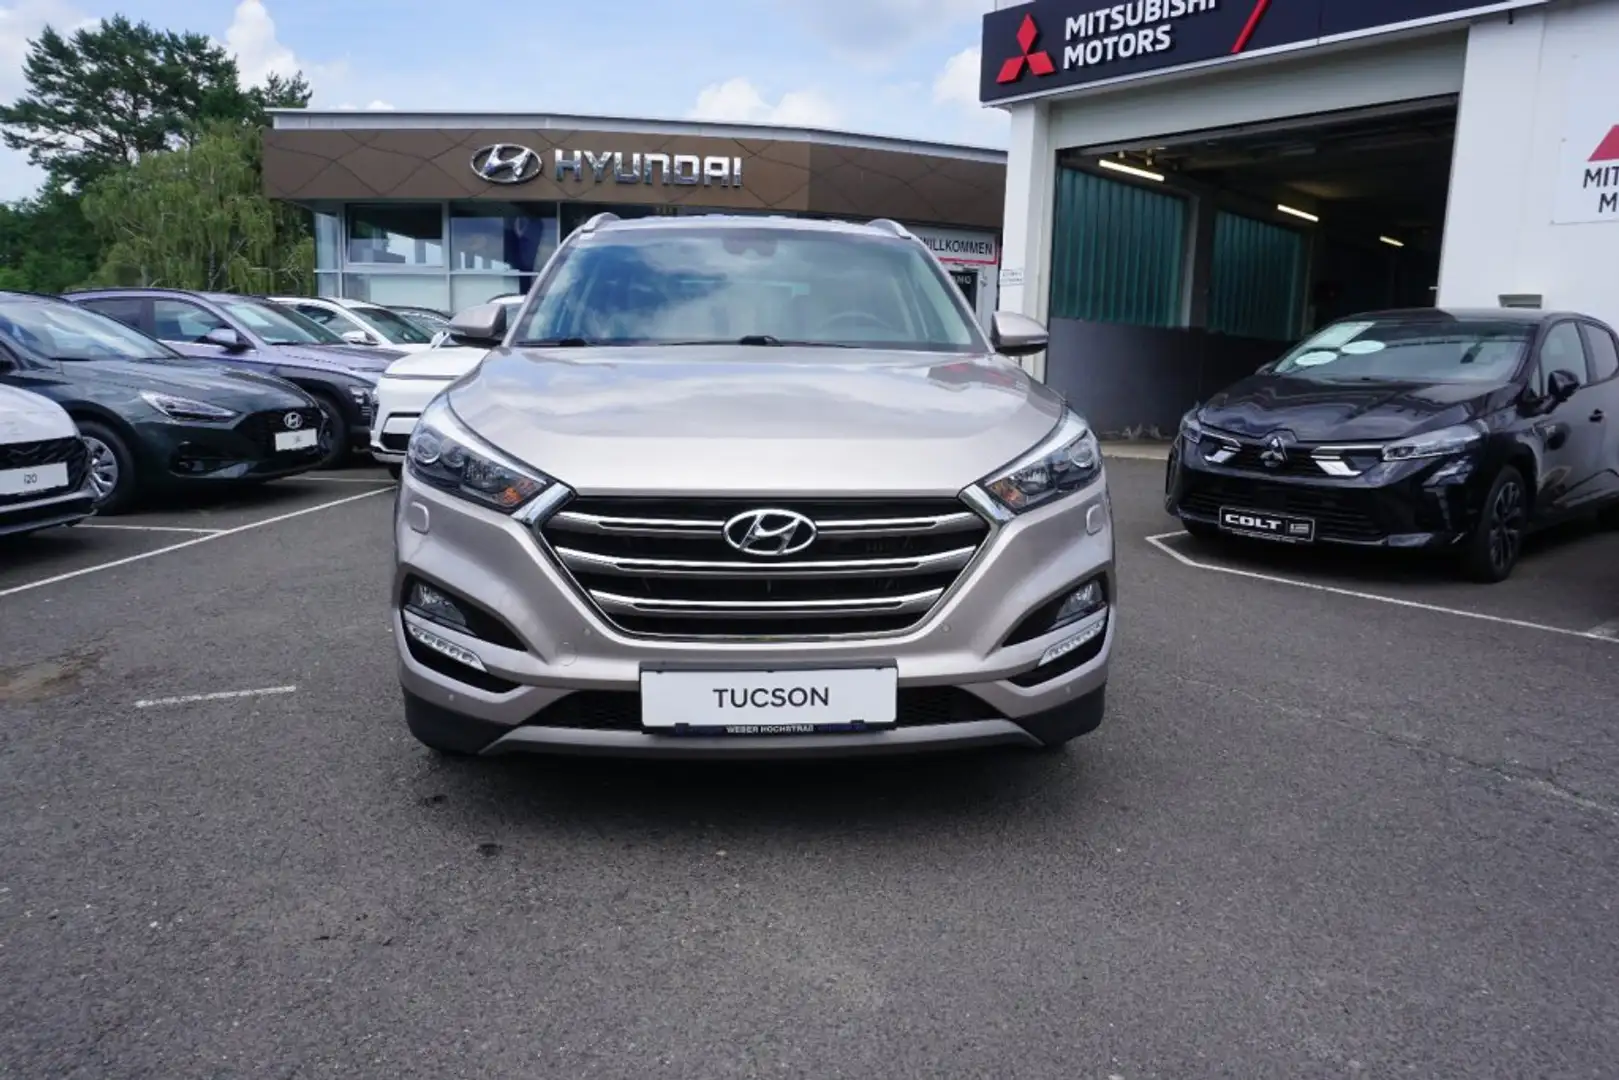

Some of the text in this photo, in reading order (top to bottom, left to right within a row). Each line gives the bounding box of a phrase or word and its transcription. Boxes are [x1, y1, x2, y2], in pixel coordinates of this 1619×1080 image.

[1063, 24, 1171, 69] MOTORS
[554, 149, 742, 188] HYUNDAI
[1225, 514, 1282, 530] COLT
[712, 686, 829, 708] TUCSON
